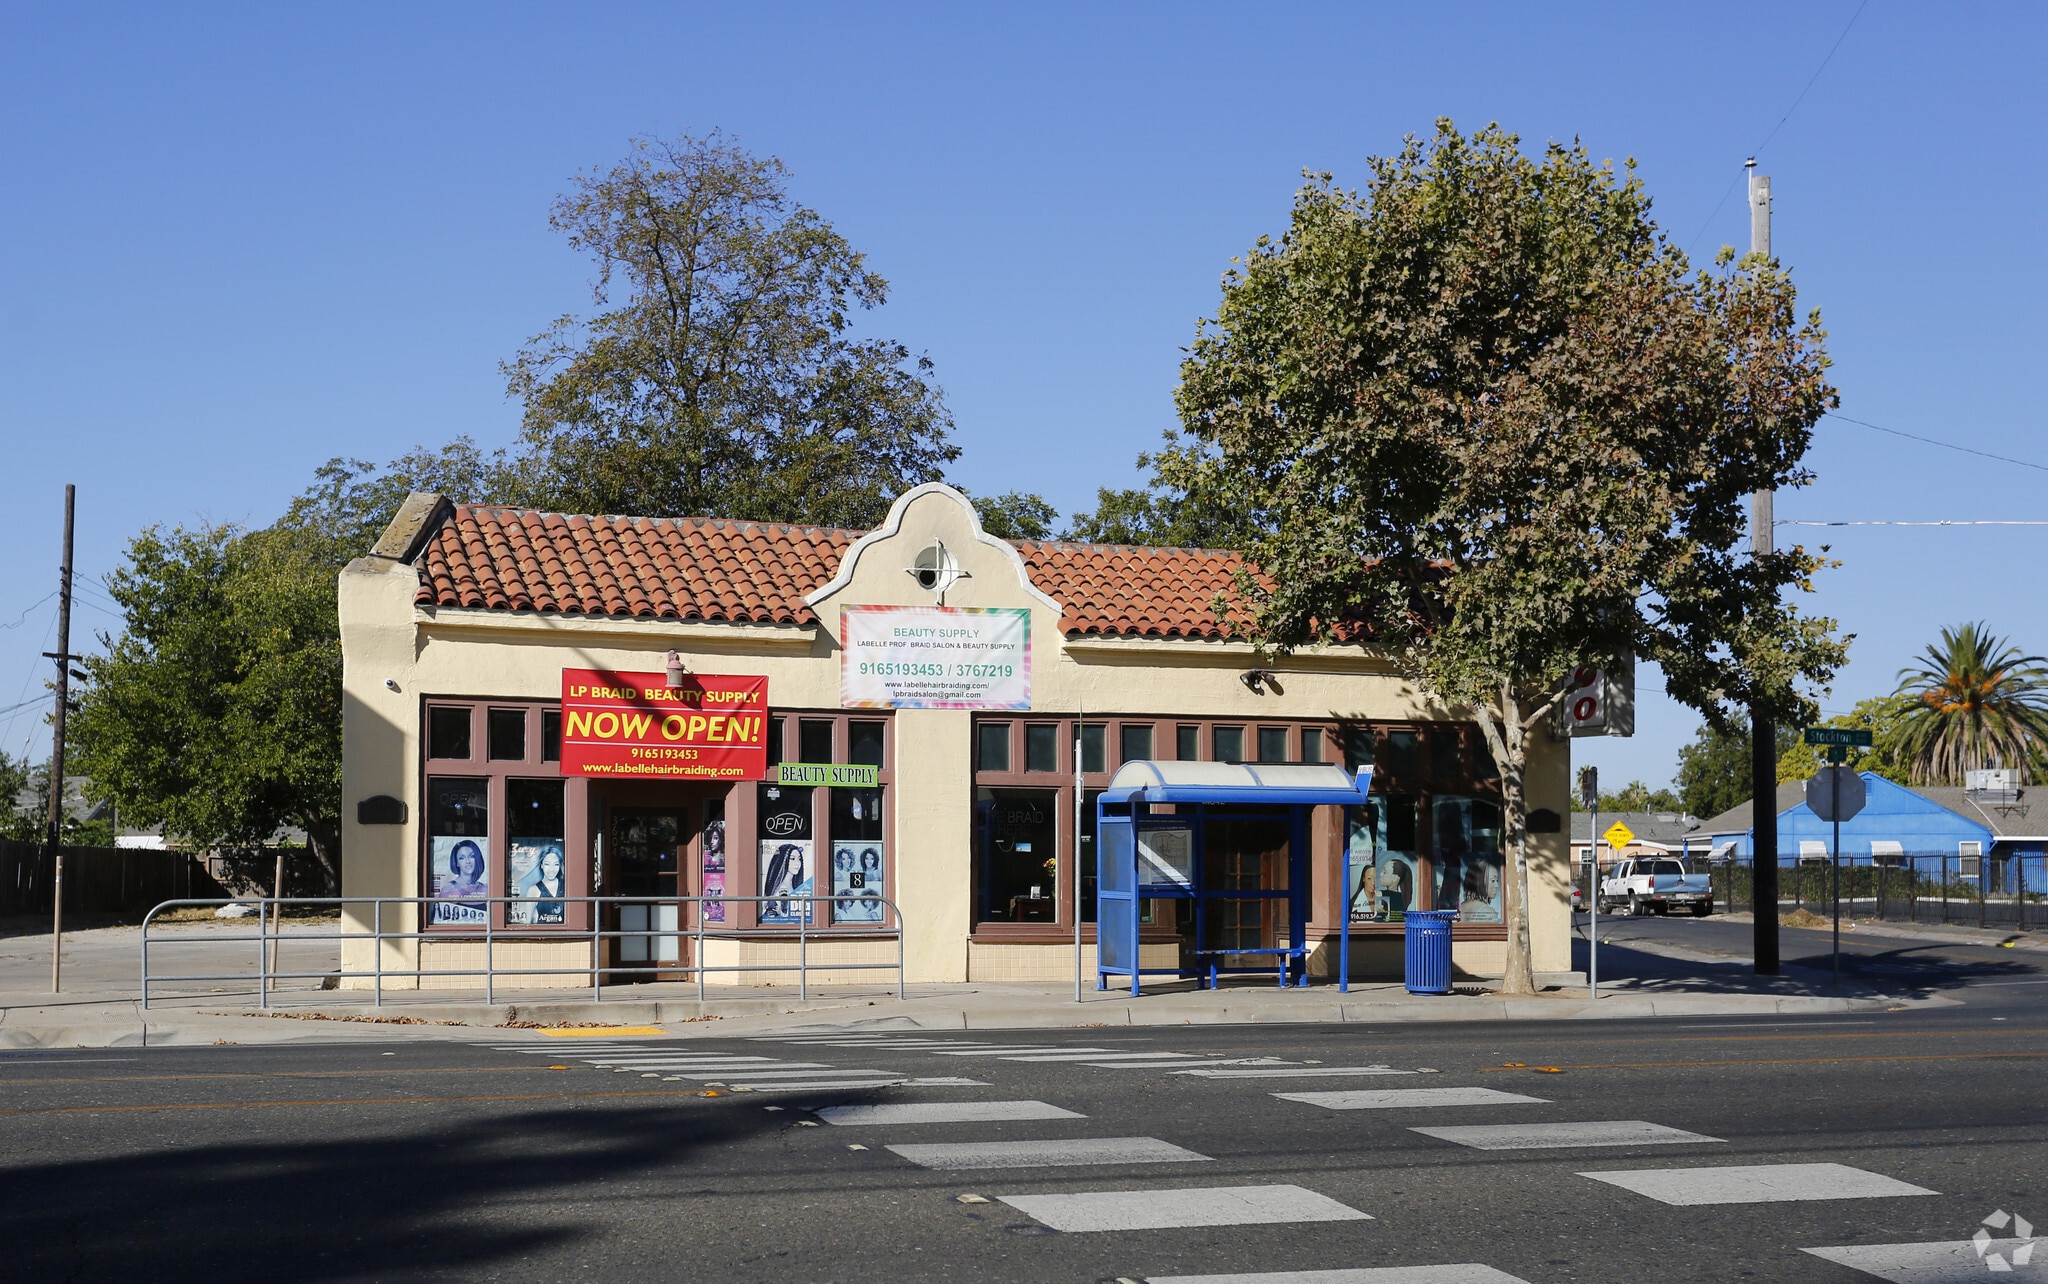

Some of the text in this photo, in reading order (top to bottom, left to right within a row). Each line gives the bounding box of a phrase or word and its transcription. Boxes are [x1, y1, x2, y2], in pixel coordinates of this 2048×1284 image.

[894, 627, 980, 639] BEAUTY SUPPLY
[857, 640, 888, 648] LABELLE
[910, 641, 931, 649] BRAID
[963, 642, 988, 650] BEAUTY
[859, 662, 1013, 678] 9165193453 / 3767219
[570, 685, 761, 704] LP BRAID BEAUTY SUPPLY
[892, 690, 981, 699] lpbraidsalon@gmail.com
[565, 711, 761, 743] NOW OPEN!
[1810, 730, 1852, 743] Stockton
[631, 748, 698, 760] 9165193453
[582, 763, 744, 778] www.labellehairbraiding.com
[781, 766, 875, 784] BEAUTY SUPPLY
[766, 817, 804, 831] OPEN
[1007, 811, 1044, 824] BRAID
[853, 875, 862, 887] 8
